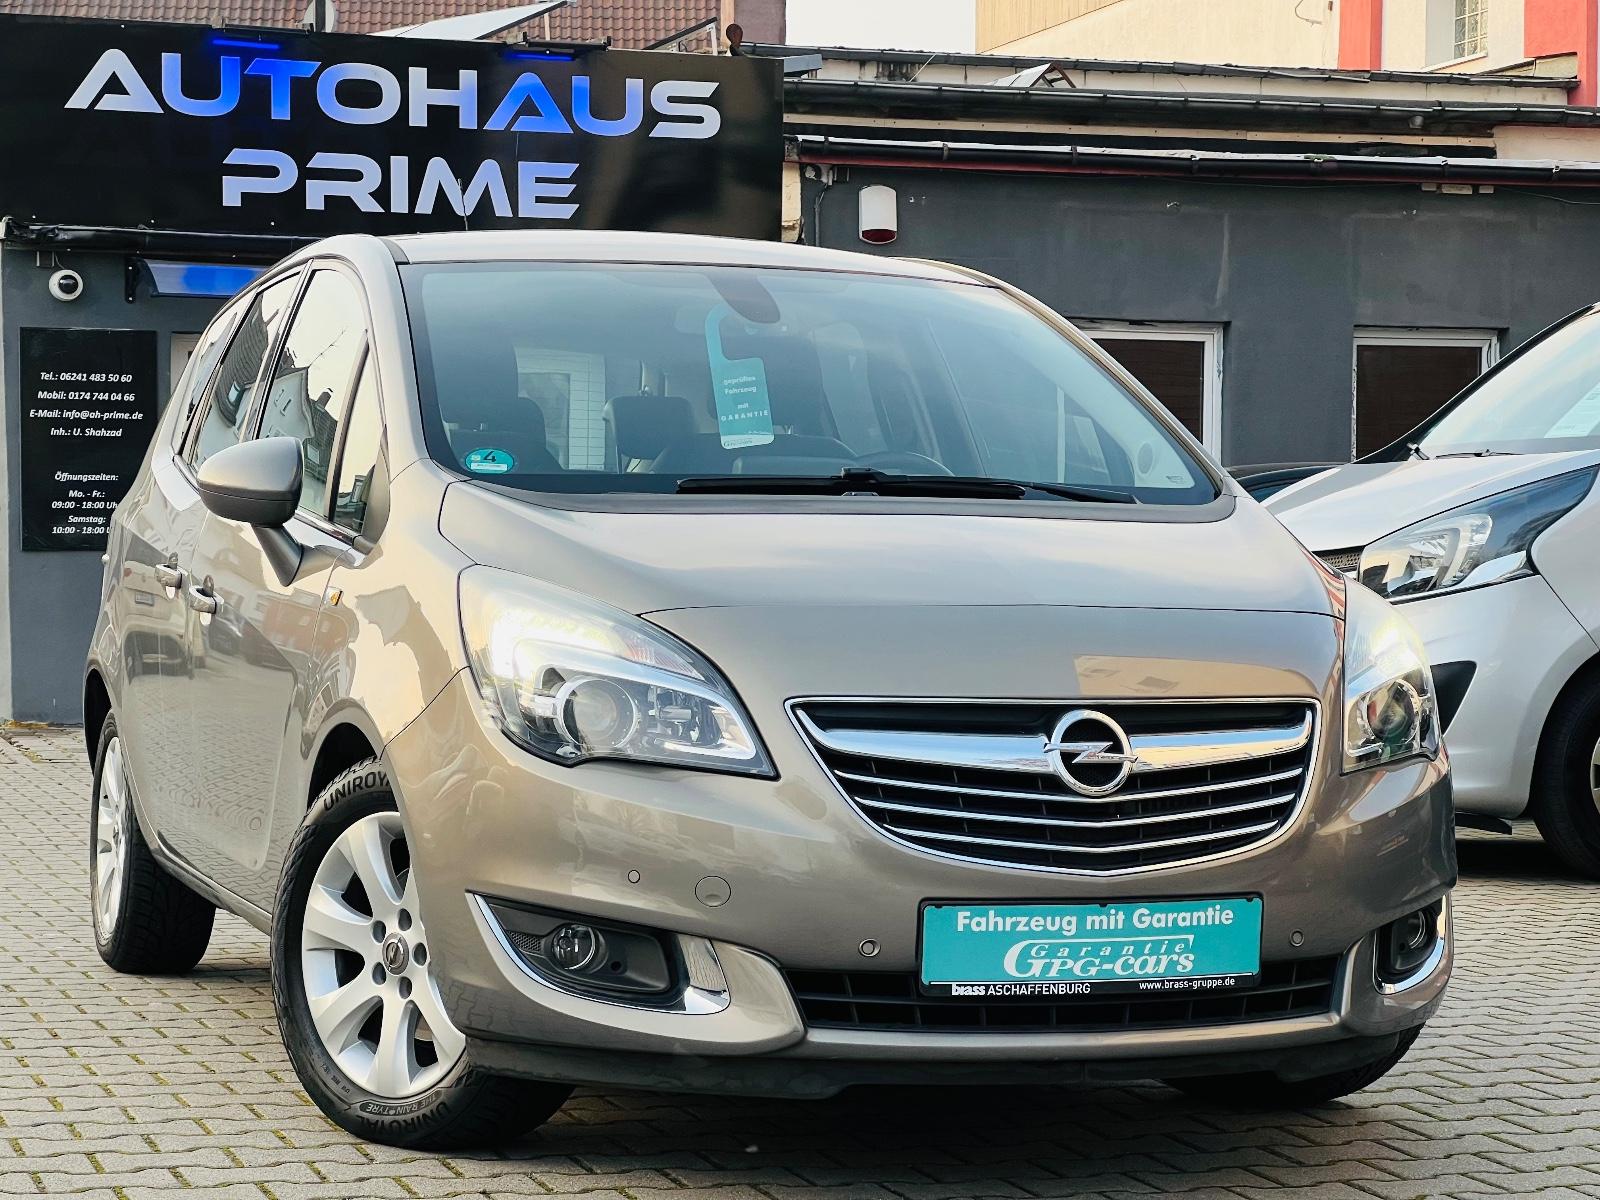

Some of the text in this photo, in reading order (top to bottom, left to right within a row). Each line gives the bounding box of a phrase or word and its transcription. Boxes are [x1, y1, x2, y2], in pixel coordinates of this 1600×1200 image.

[64, 49, 721, 139] AUTOHAUS
[222, 148, 580, 219] PRIME
[40, 372, 133, 383] Tel.: 06241 483 50 60
[725, 386, 757, 395] Fahrzeug
[37, 391, 136, 402] Mobil: 0174 744 04 66
[29, 409, 144, 420] E-Mail: info@ah-prime.de
[721, 410, 769, 421] GARANTIE
[50, 427, 123, 437] Inh.: U. Shahzad
[483, 451, 496, 462] 4
[54, 471, 119, 482] Öffnungszeiten:
[68, 489, 85, 498] Mo.
[91, 490, 106, 498] Fr.:
[51, 501, 76, 509] 09:00
[81, 501, 105, 509] 18:00
[106, 501, 118, 509] Uh
[67, 515, 107, 525] Samstag:
[51, 526, 76, 534] 10:00
[81, 526, 105, 534] 18:00
[323, 771, 390, 811] UNIROY
[956, 904, 1235, 937] Fahrzeug mit Garantie
[1029, 940, 1186, 959] Garantie
[951, 976, 1236, 997] brass ASCHAFFENBURG www.brass-gruppe.de
[365, 1102, 390, 1116] TYRE
[394, 1098, 418, 1116] RAIN
[355, 1100, 450, 1137] UNIROYAL
